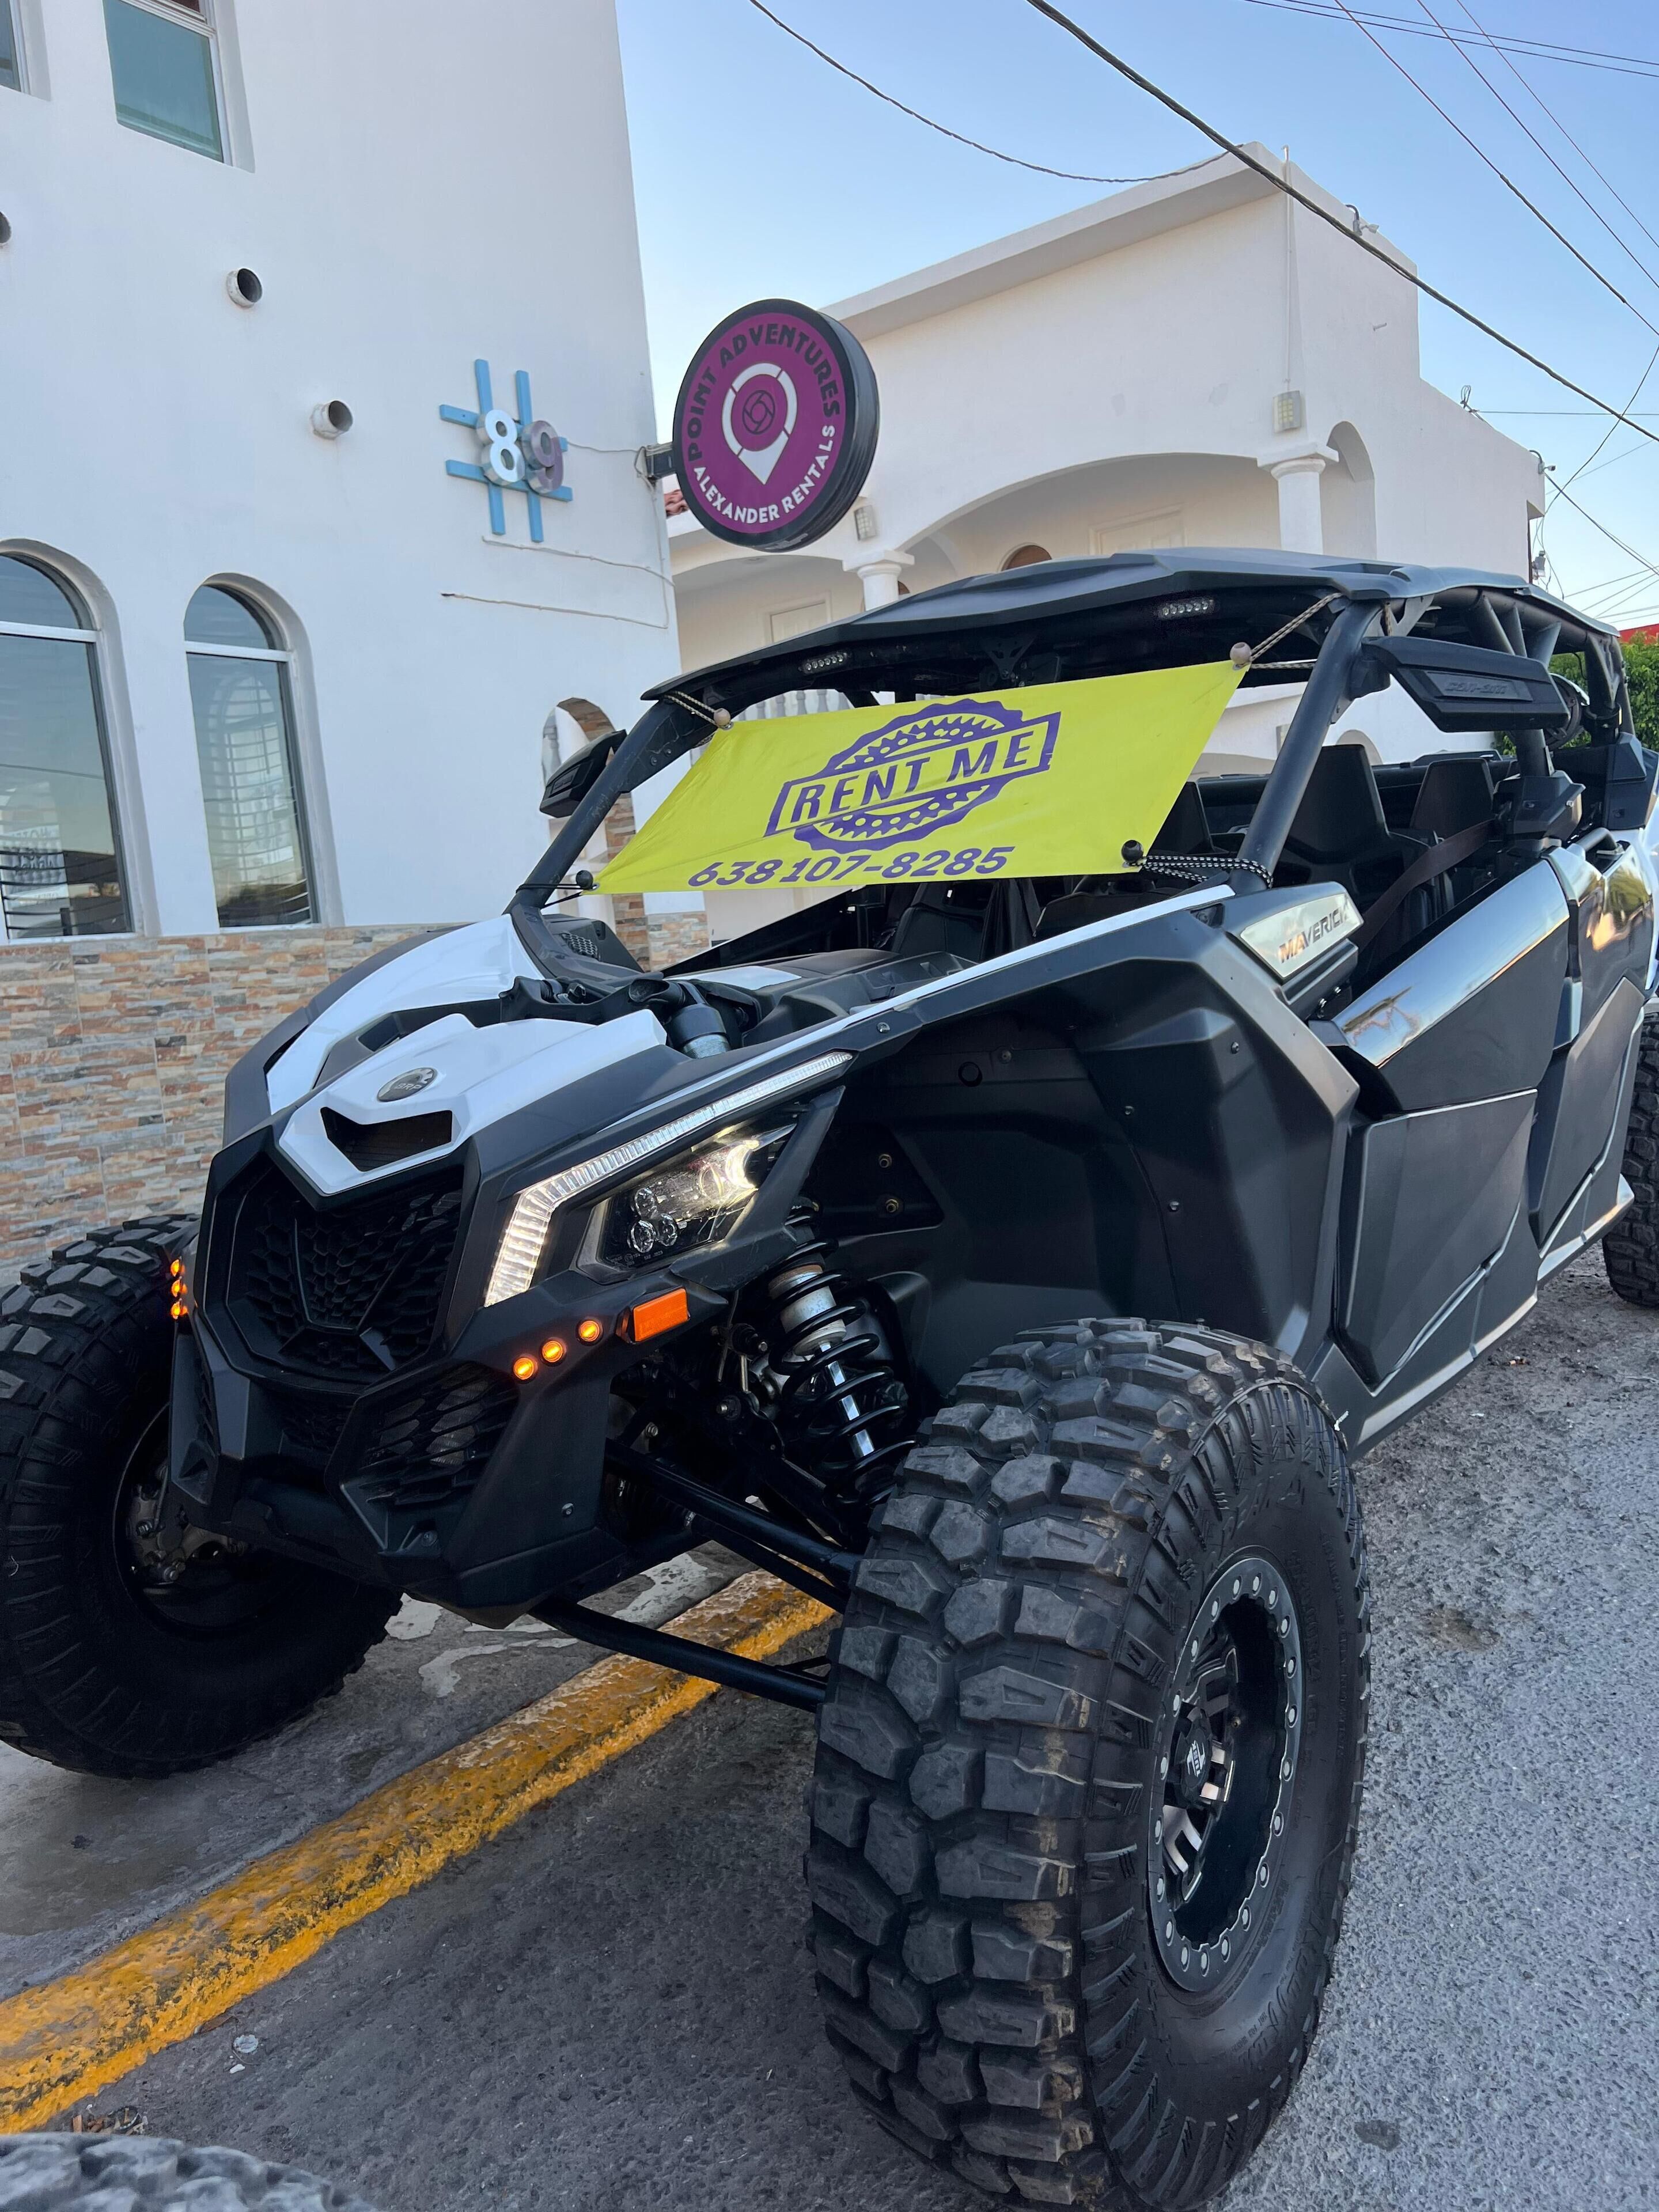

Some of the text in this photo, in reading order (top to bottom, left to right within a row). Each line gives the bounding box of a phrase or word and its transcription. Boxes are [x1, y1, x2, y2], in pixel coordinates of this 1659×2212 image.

[687, 323, 840, 461] POINT ADVENTURES
[694, 425, 835, 524] ALEXANDER RENTALS
[790, 730, 1034, 823] RENT ME
[1278, 902, 1349, 964] MAVERICK
[393, 1083, 422, 1091] BRP
